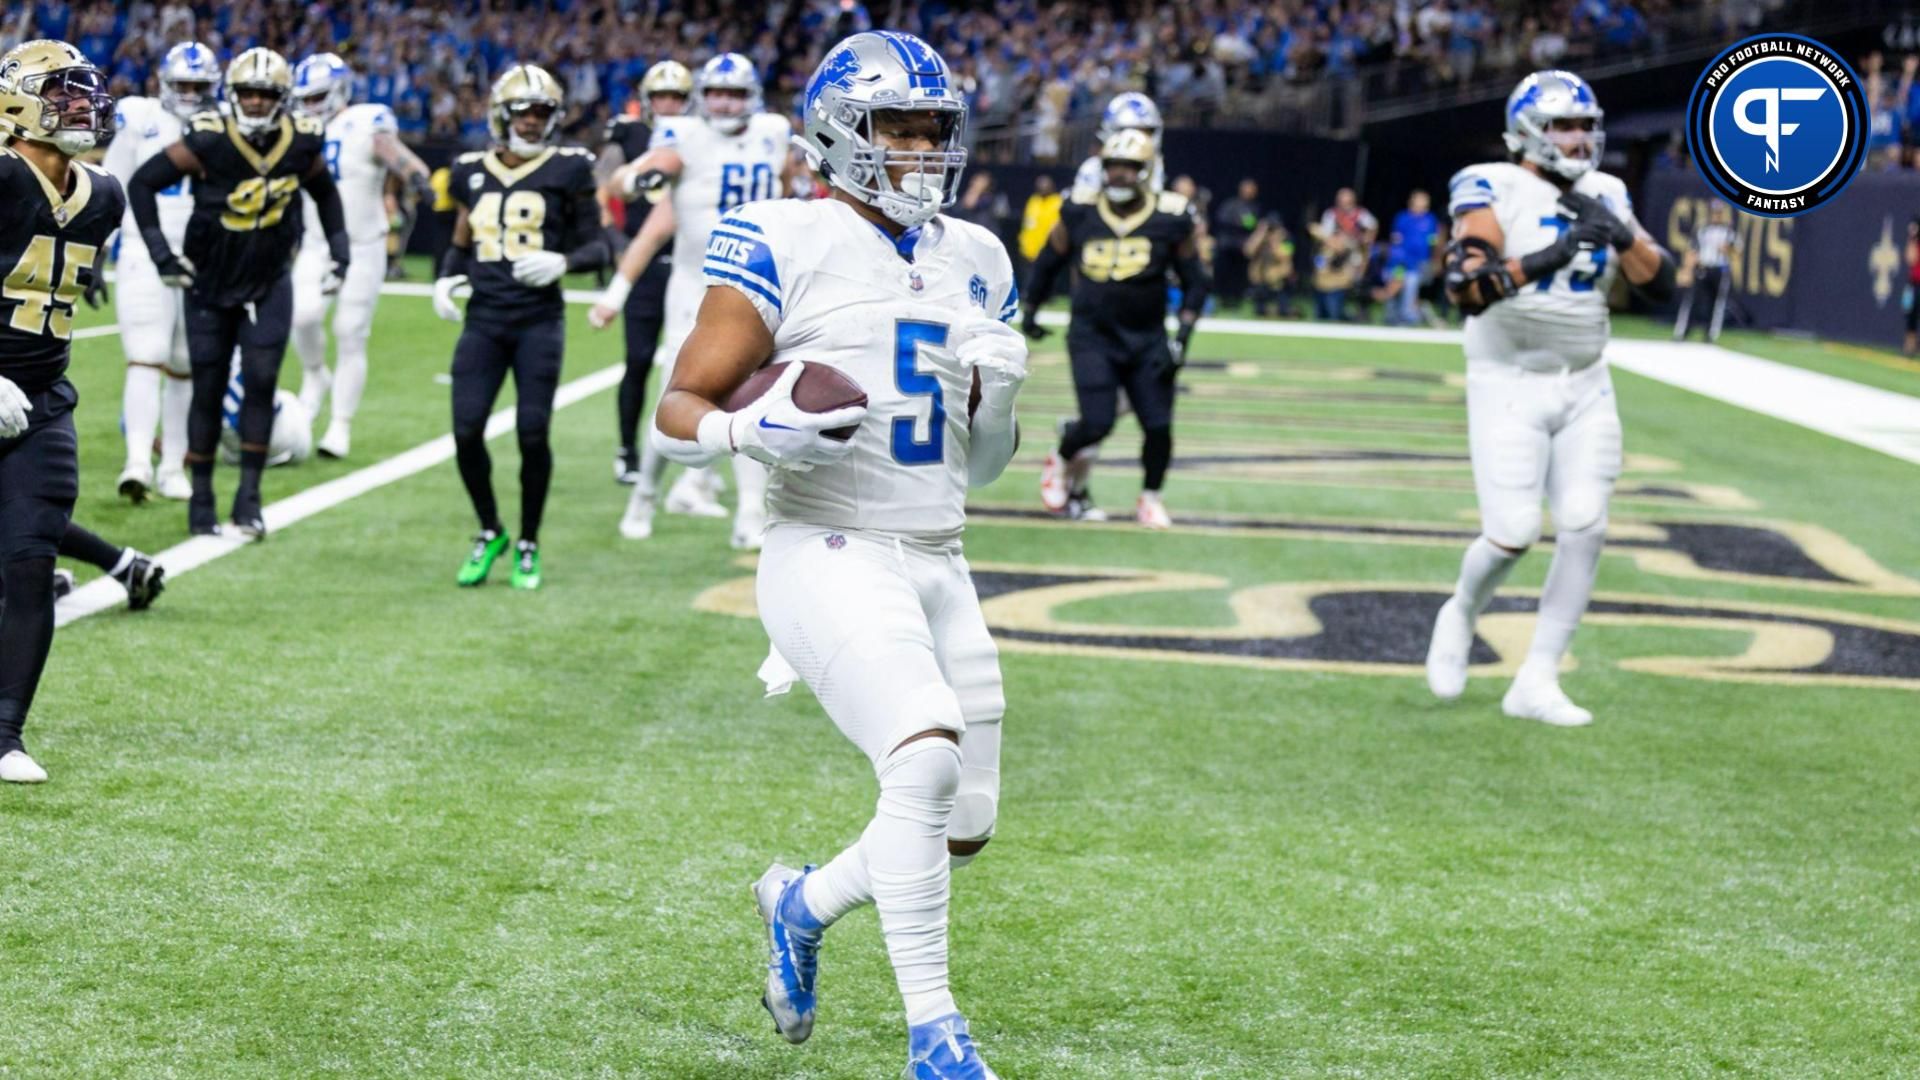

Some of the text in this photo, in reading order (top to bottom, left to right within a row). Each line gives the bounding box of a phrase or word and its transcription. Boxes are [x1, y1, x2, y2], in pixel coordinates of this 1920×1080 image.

[219, 173, 300, 232] 97
[717, 163, 773, 215] 60
[469, 190, 546, 262] 48
[2, 234, 98, 340] 45
[889, 317, 951, 467] 5
